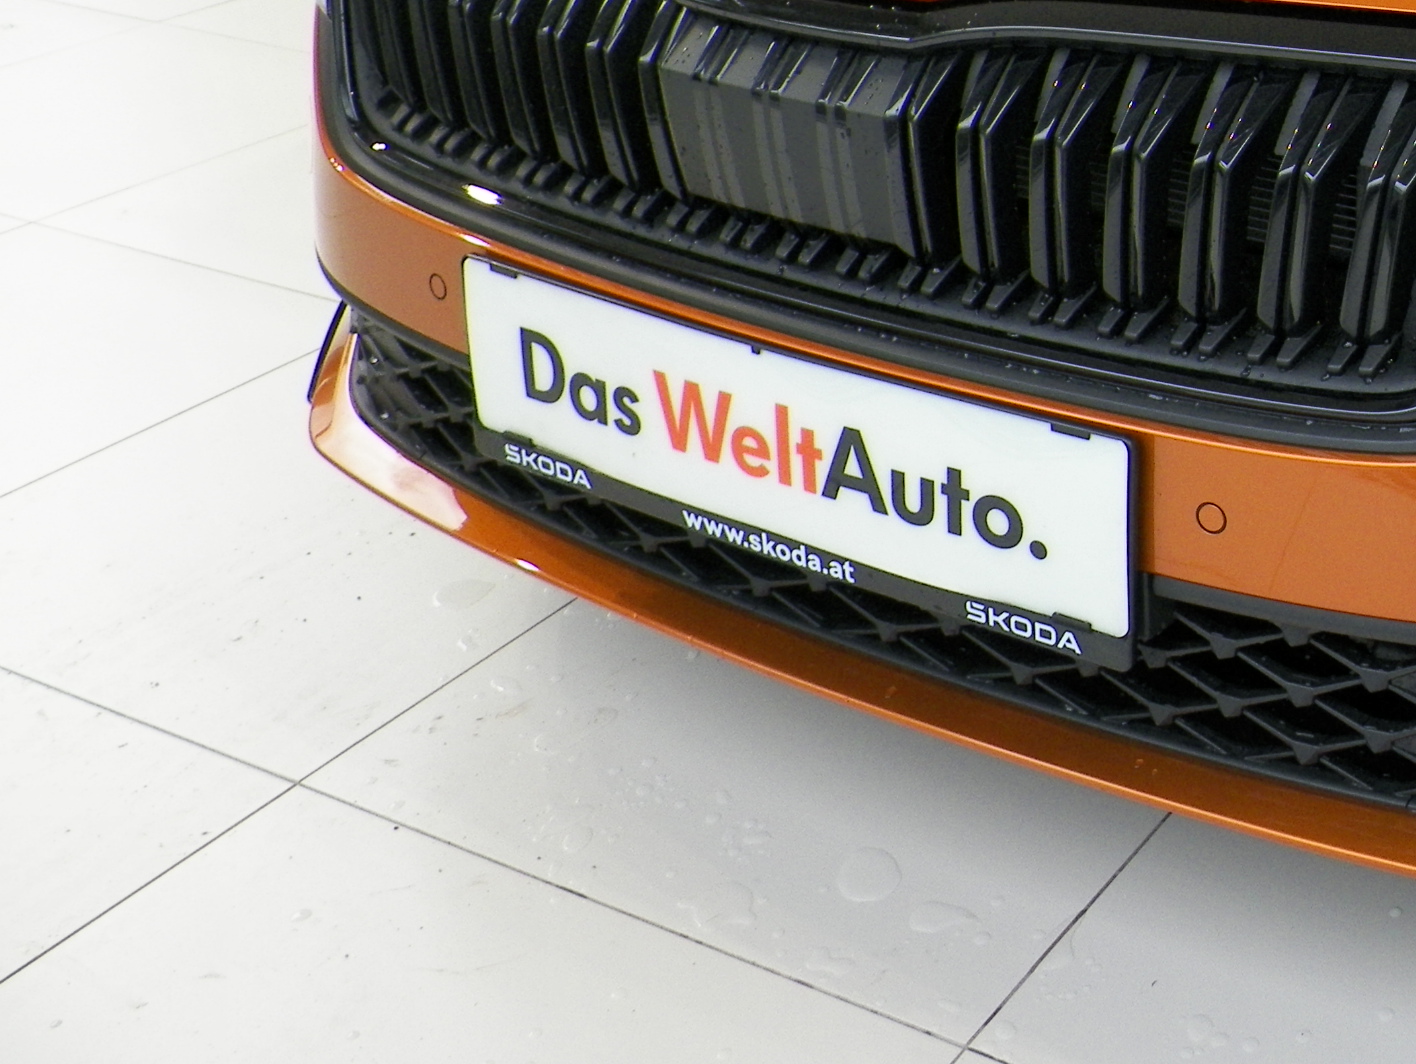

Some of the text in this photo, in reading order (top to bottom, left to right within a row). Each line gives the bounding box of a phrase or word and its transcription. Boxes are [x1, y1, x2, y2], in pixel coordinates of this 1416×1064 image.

[520, 326, 1048, 560] Das WeltAuto.
[682, 509, 855, 584] www.skoda.at
